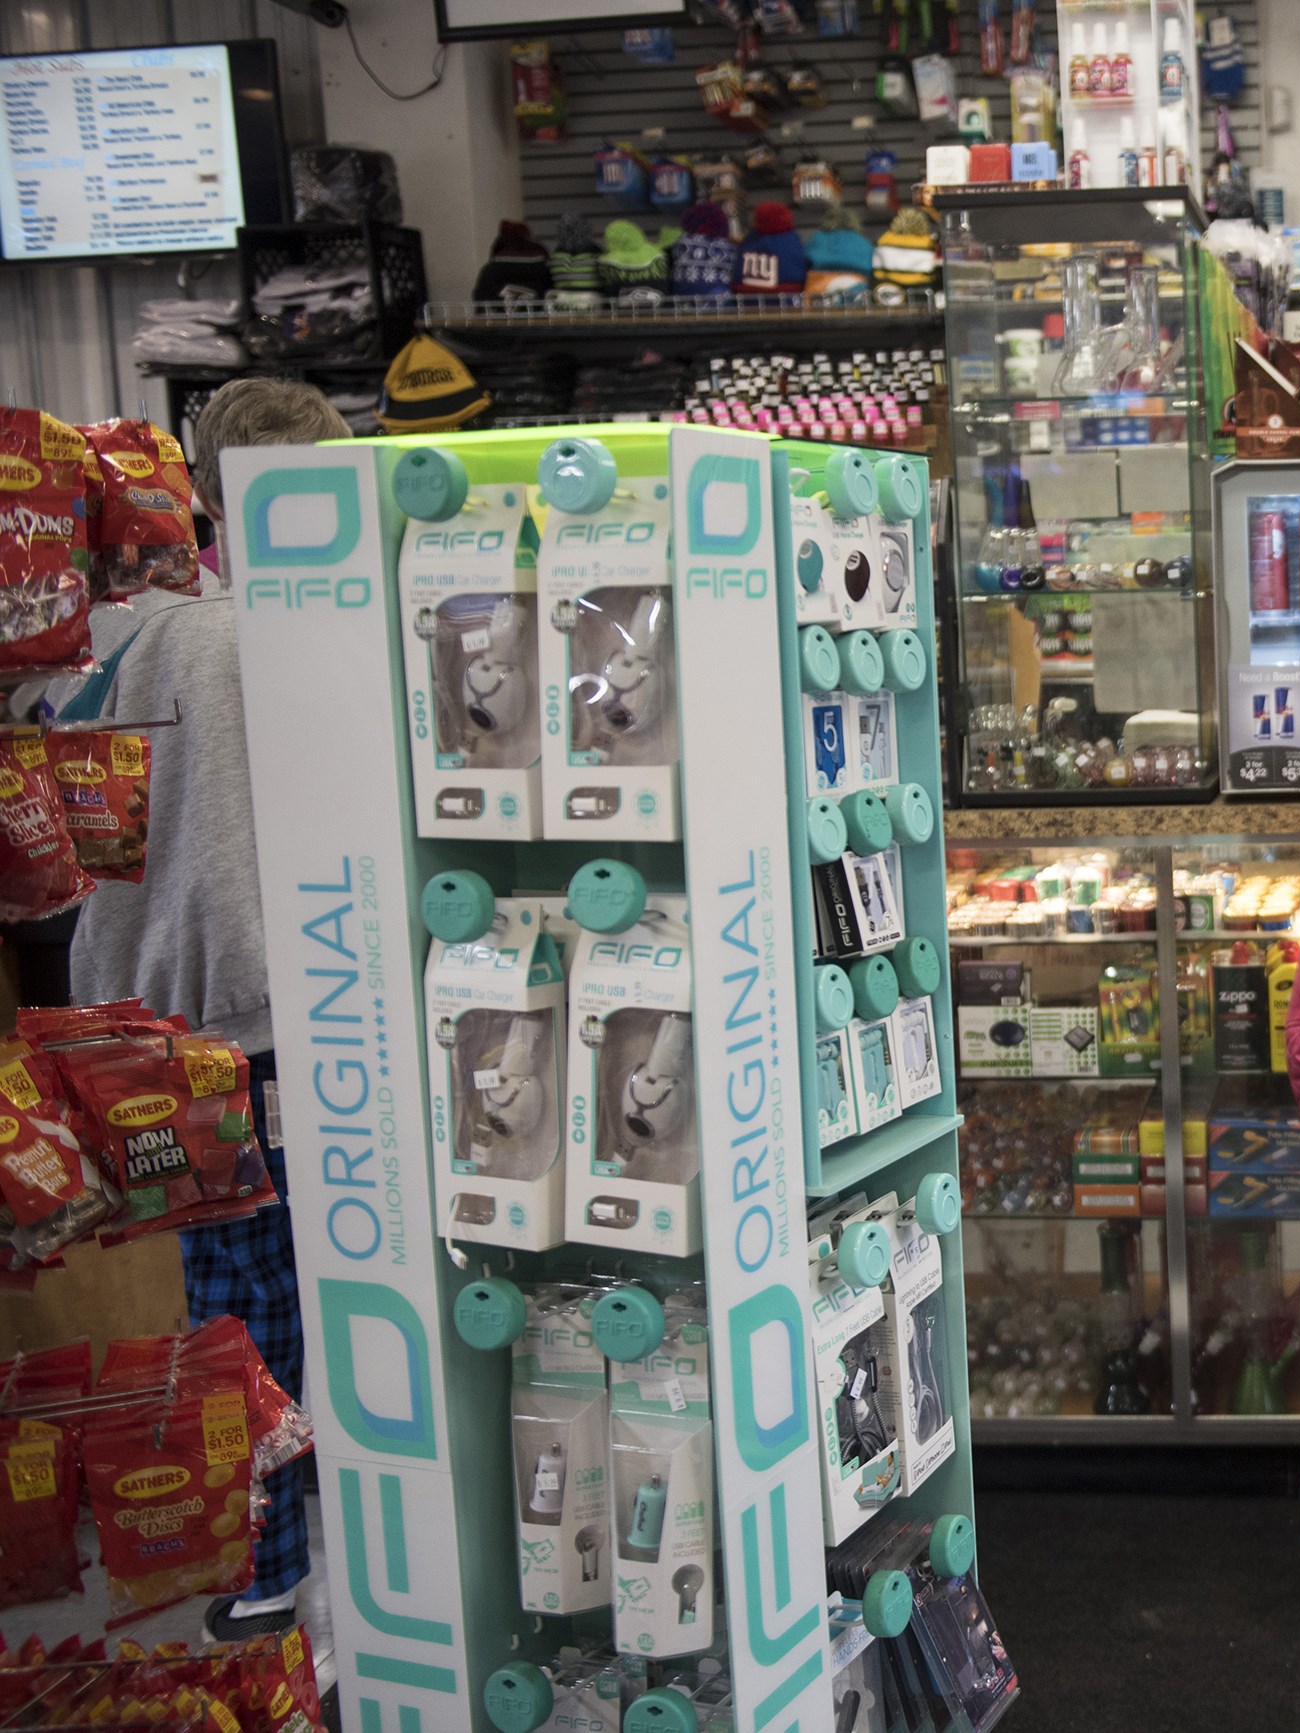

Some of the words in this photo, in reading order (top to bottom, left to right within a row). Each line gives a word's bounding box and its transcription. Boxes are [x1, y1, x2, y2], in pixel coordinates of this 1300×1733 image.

[416, 530, 504, 551] FIFO
[556, 521, 655, 544] FIFO
[246, 578, 371, 609] FIFO
[686, 568, 767, 600] FIFO
[822, 711, 838, 752] 5
[865, 704, 882, 750] 7
[113, 752, 140, 764] $1.50
[66, 810, 119, 830] aramels
[358, 855, 380, 912] 2000
[758, 845, 774, 901] 2000
[835, 903, 853, 947] FIFO
[365, 922, 387, 990] SINCE
[440, 943, 520, 970] FIFO
[589, 941, 682, 968] FIFO
[763, 908, 778, 981] SINCE
[456, 986, 473, 999] USB
[607, 984, 626, 997] USB
[298, 855, 381, 1261] ORIGINAL
[718, 849, 774, 1274] ORIGINAL
[112, 1098, 174, 1123] SATHERS
[379, 1086, 399, 1155] SOLD
[768, 1076, 786, 1144] SOLD
[126, 1126, 175, 1157] NOW
[128, 1146, 188, 1179] LATER
[386, 1168, 408, 1266] MILLIONS
[769, 1145, 791, 1259] MILLIONS
[893, 1232, 930, 1274] FIFO
[521, 1326, 594, 1349] FIFO
[816, 1340, 831, 1355] Extra
[831, 1332, 846, 1348] Long
[859, 1313, 871, 1327] USB
[208, 1431, 217, 1439] 2
[219, 1425, 244, 1436] FOR
[208, 1434, 245, 1451] $1.50
[119, 1470, 187, 1494] SATHERS
[114, 1498, 204, 1527] Butterscotch
[317, 1277, 456, 1733] IFO
[728, 1283, 823, 1733] IFO
[138, 1517, 185, 1538] Discs
[555, 1715, 603, 1733] FIFO
